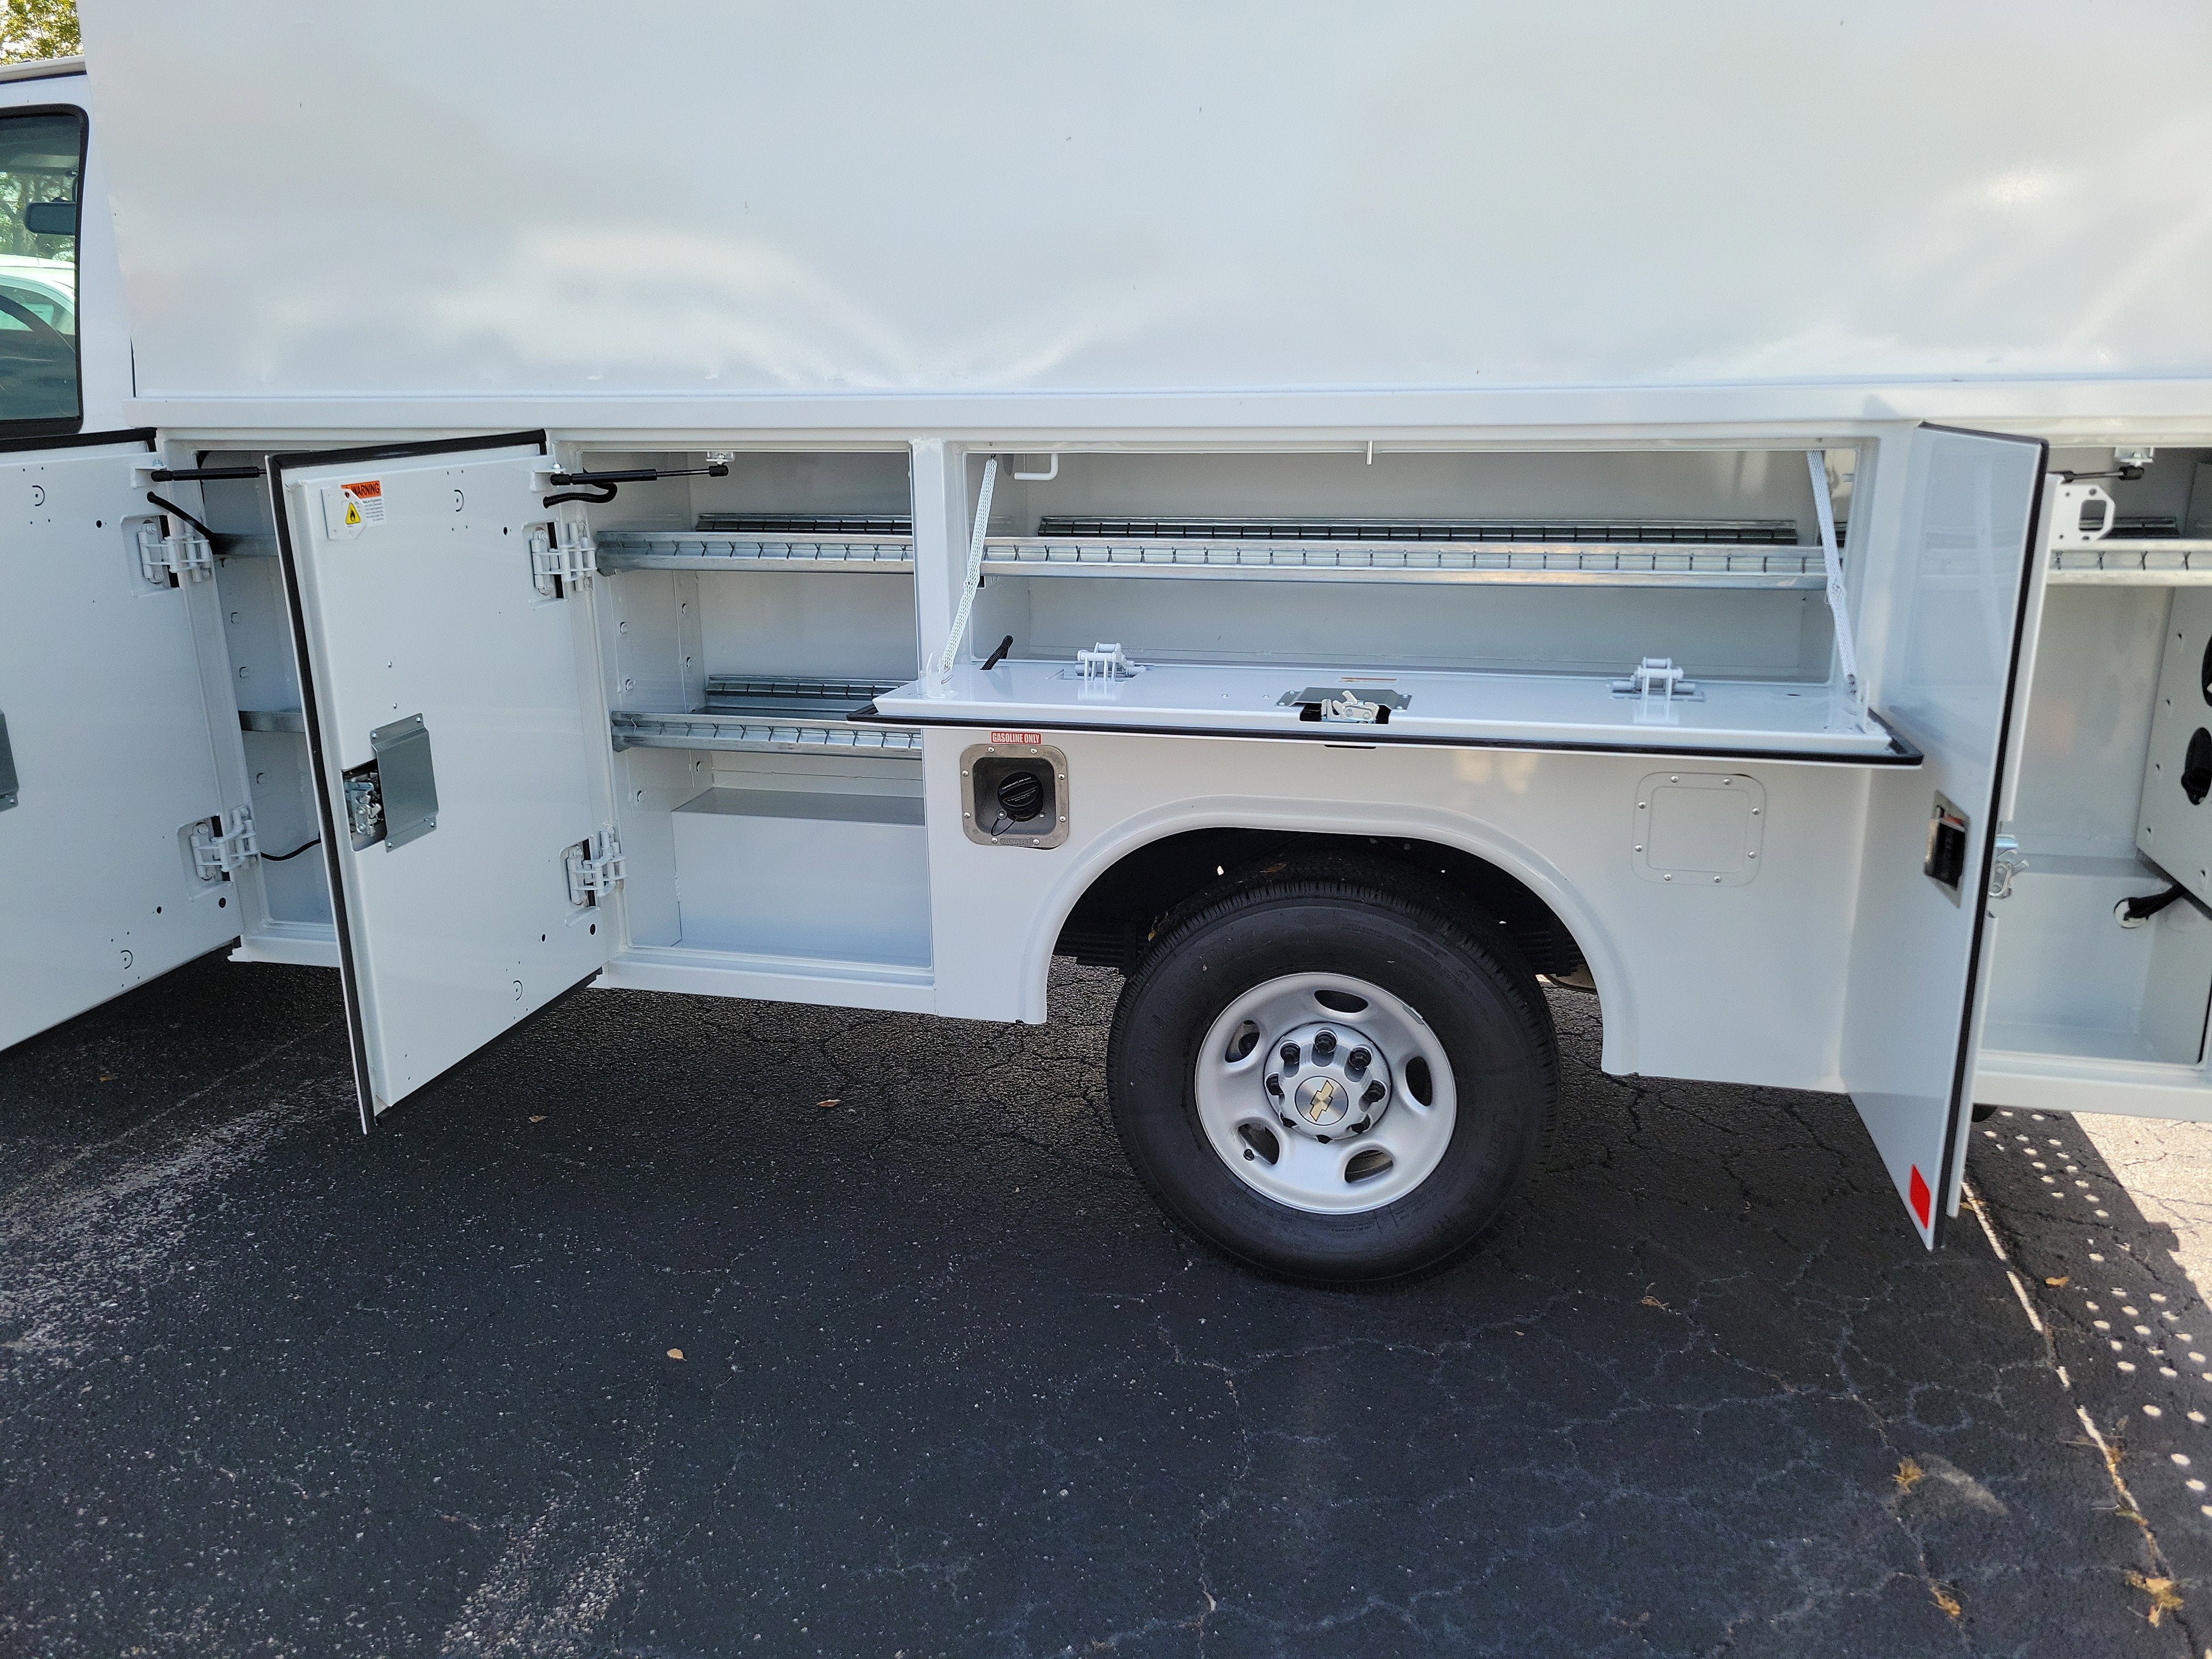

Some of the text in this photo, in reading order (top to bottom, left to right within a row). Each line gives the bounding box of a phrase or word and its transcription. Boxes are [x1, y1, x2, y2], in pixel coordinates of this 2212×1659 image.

[352, 483, 379, 496] WARNING
[992, 732, 1040, 743] GASOLINE ONLY
